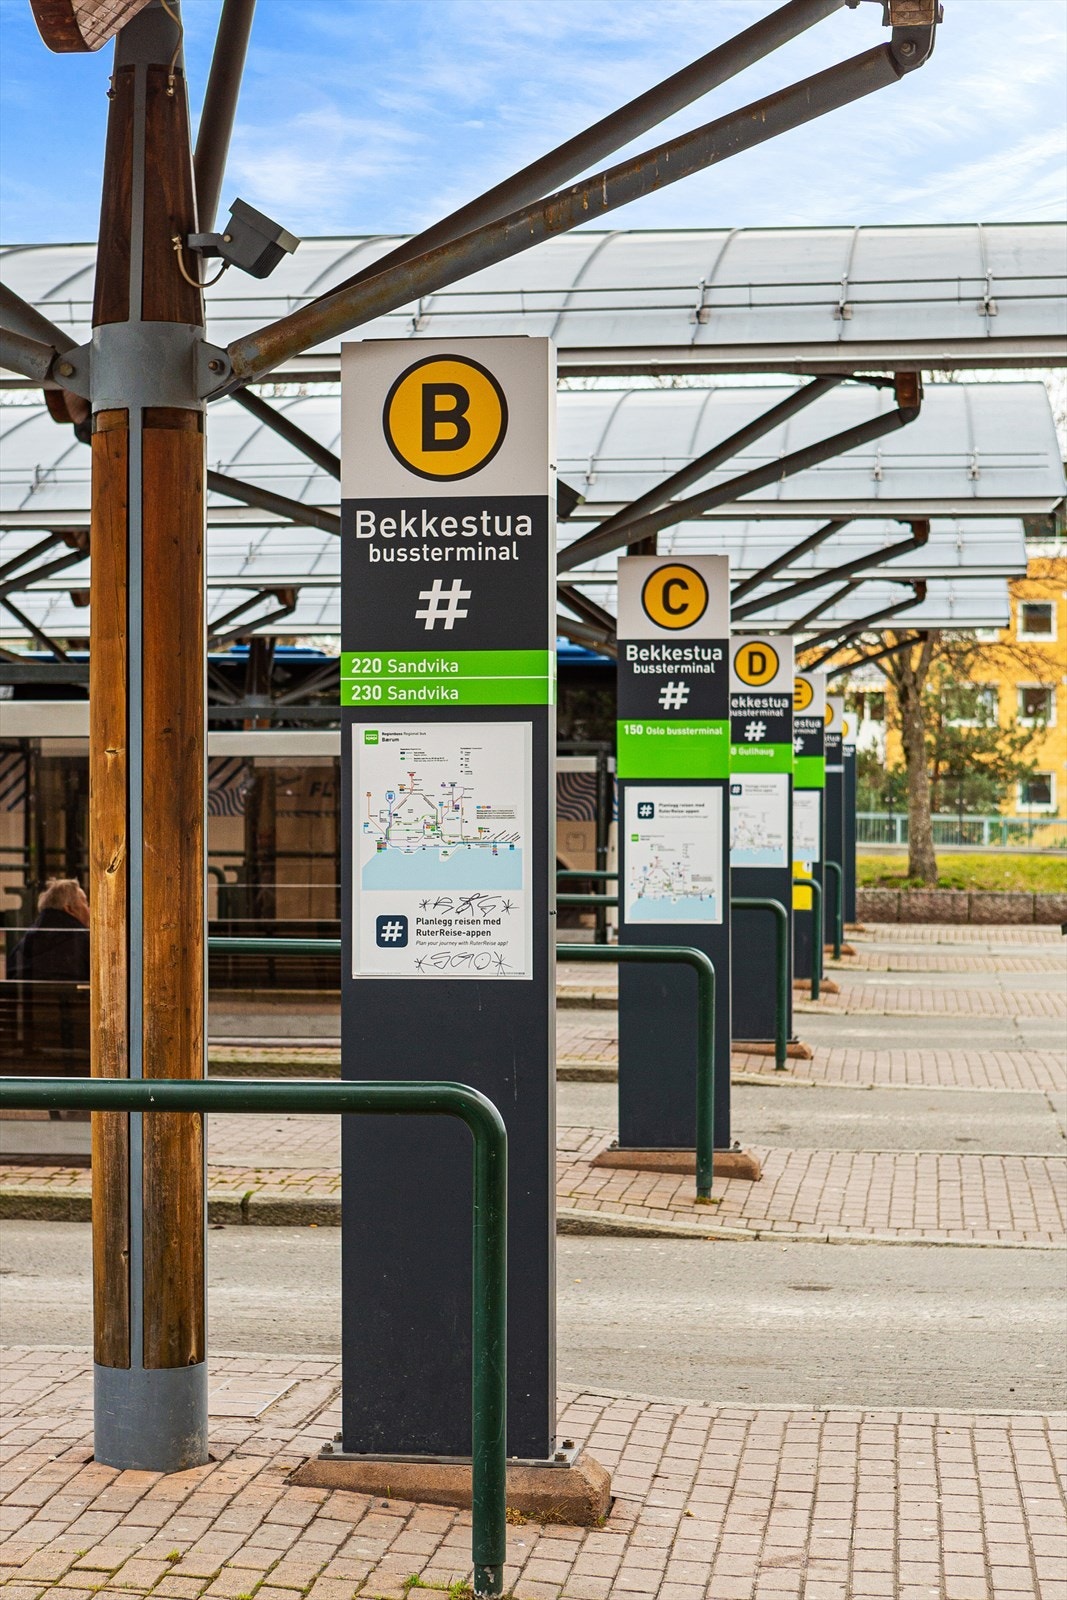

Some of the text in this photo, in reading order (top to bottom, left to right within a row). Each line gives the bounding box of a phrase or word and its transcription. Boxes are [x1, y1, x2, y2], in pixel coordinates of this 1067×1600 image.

[421, 382, 471, 452] B
[355, 509, 533, 539] Bekkestua
[369, 541, 519, 563] bussterminal
[661, 577, 690, 615] C
[625, 644, 723, 662] Bekkestua
[351, 657, 459, 674] 220 Sandvika
[633, 661, 716, 674] bussterminal
[747, 650, 768, 676] D
[351, 684, 459, 701] 230 Sandvika
[731, 696, 789, 708] ekkestua
[624, 724, 723, 736] 150 Oslo bussterminal
[416, 917, 502, 926] Planlegg reisen med
[416, 929, 492, 938] RuterReise-appen
